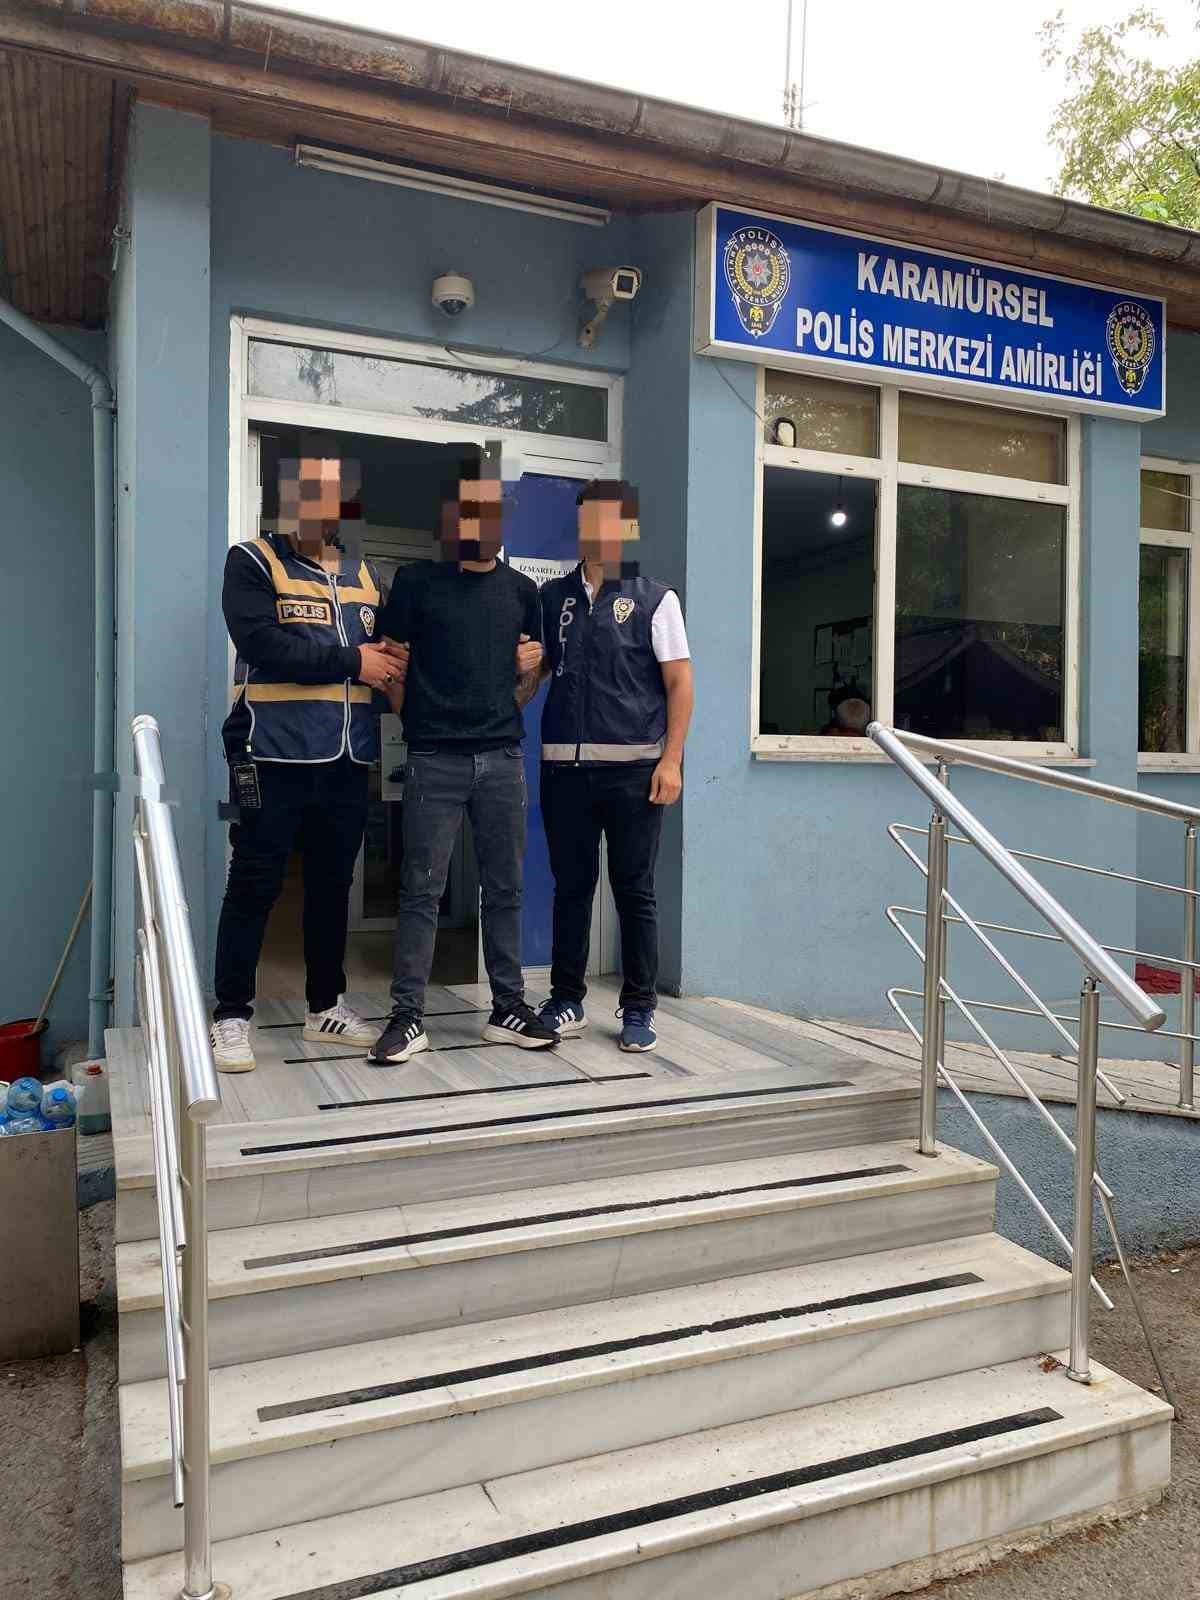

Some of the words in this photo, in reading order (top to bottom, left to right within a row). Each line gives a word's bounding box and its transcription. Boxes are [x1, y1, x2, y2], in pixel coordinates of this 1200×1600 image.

[857, 252, 1054, 328] KARAMÜRSEL
[796, 307, 875, 358] POLİS
[883, 324, 993, 378] MERKEZİ
[1000, 342, 1102, 396] AMİRLİĞİ
